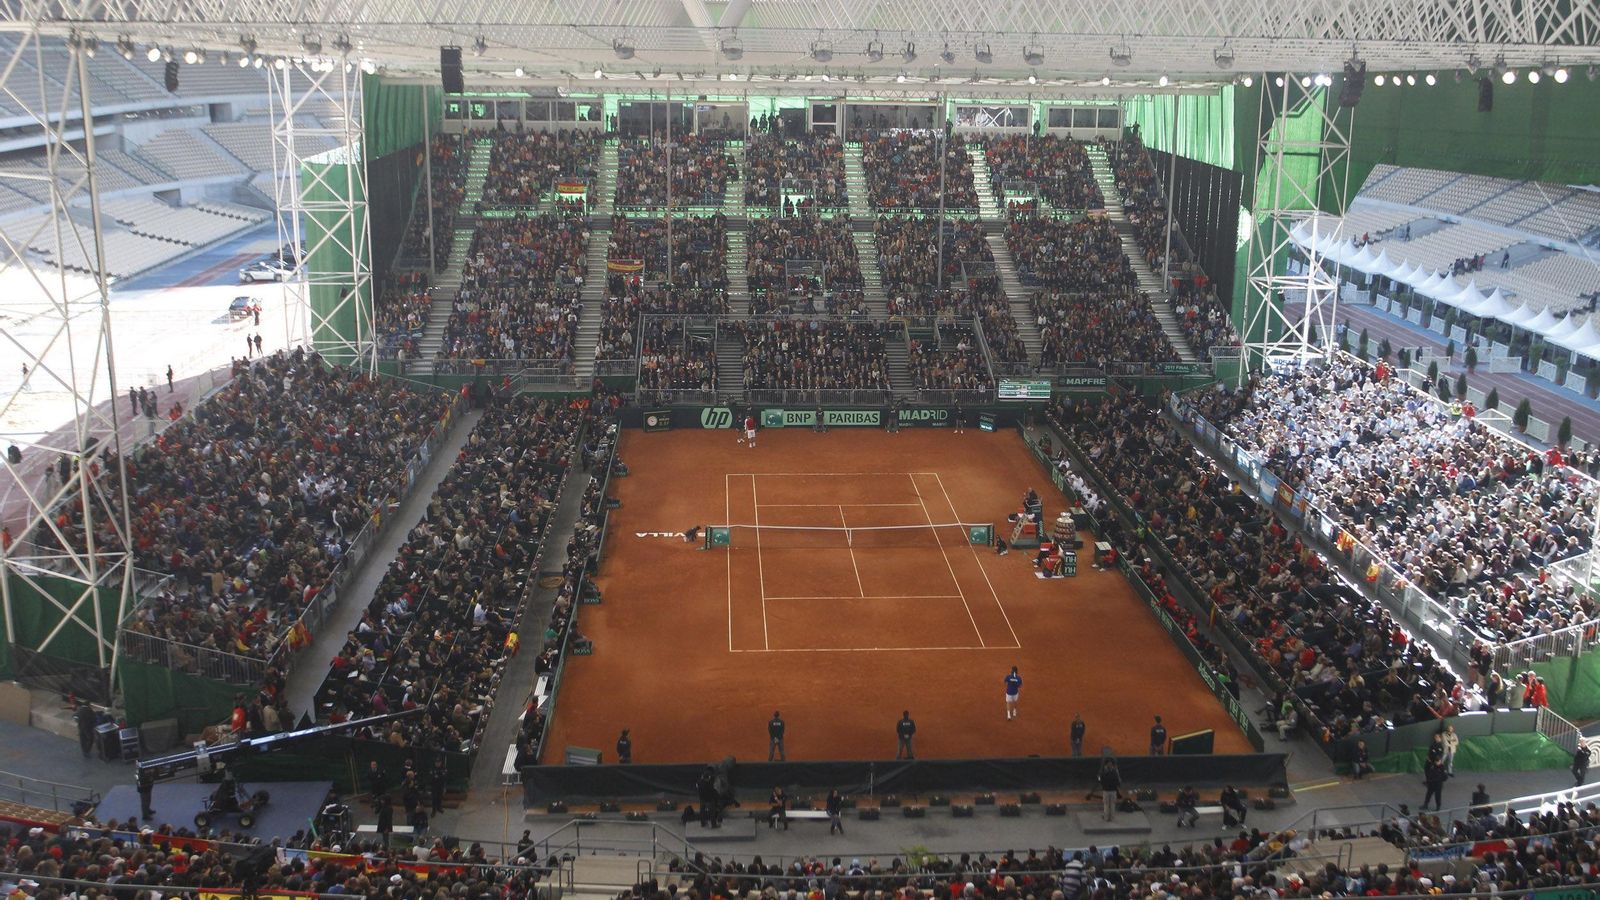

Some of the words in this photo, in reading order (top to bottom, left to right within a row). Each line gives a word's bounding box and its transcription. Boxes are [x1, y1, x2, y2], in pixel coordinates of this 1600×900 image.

[705, 408, 730, 429] hp
[787, 413, 811, 423] BNP
[829, 413, 879, 423] PARIBAS
[899, 409, 948, 420] MADRID
